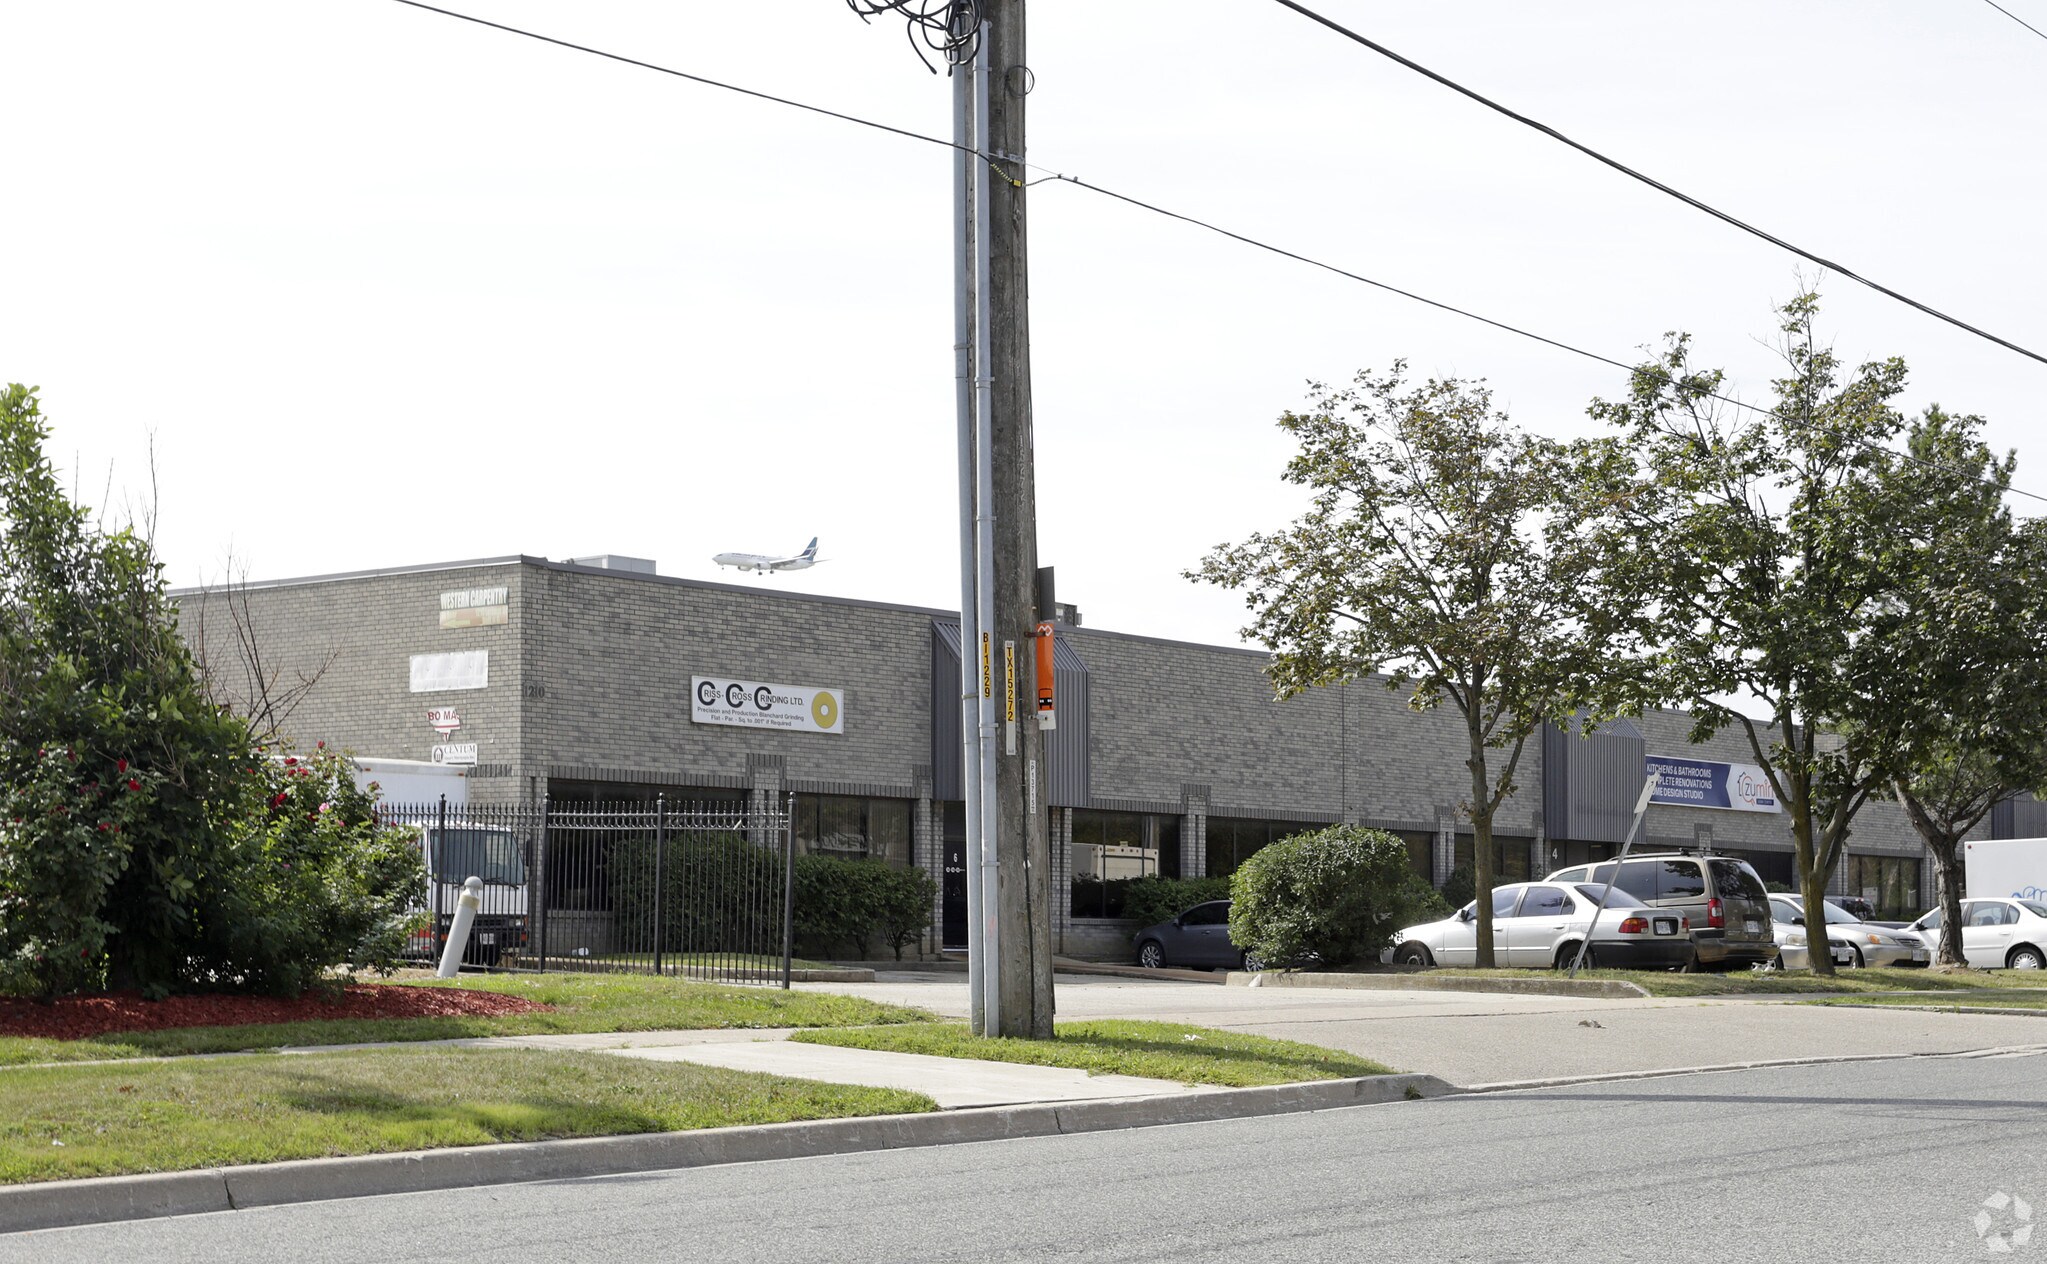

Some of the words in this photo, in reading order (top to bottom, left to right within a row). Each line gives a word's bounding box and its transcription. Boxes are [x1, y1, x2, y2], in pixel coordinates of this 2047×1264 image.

[697, 706, 720, 714] Precision
[731, 709, 758, 717] Production
[759, 711, 783, 719] Blanchard
[784, 714, 804, 722] Grinding
[770, 719, 792, 727] Required
[1678, 767, 1712, 778] BATHROOMS
[1675, 777, 1713, 789] RENOVATIONS
[1664, 787, 1684, 798] DESIGN
[1684, 789, 1704, 800] STUDIO
[953, 853, 958, 863] 6
[1552, 847, 1558, 860] 4
